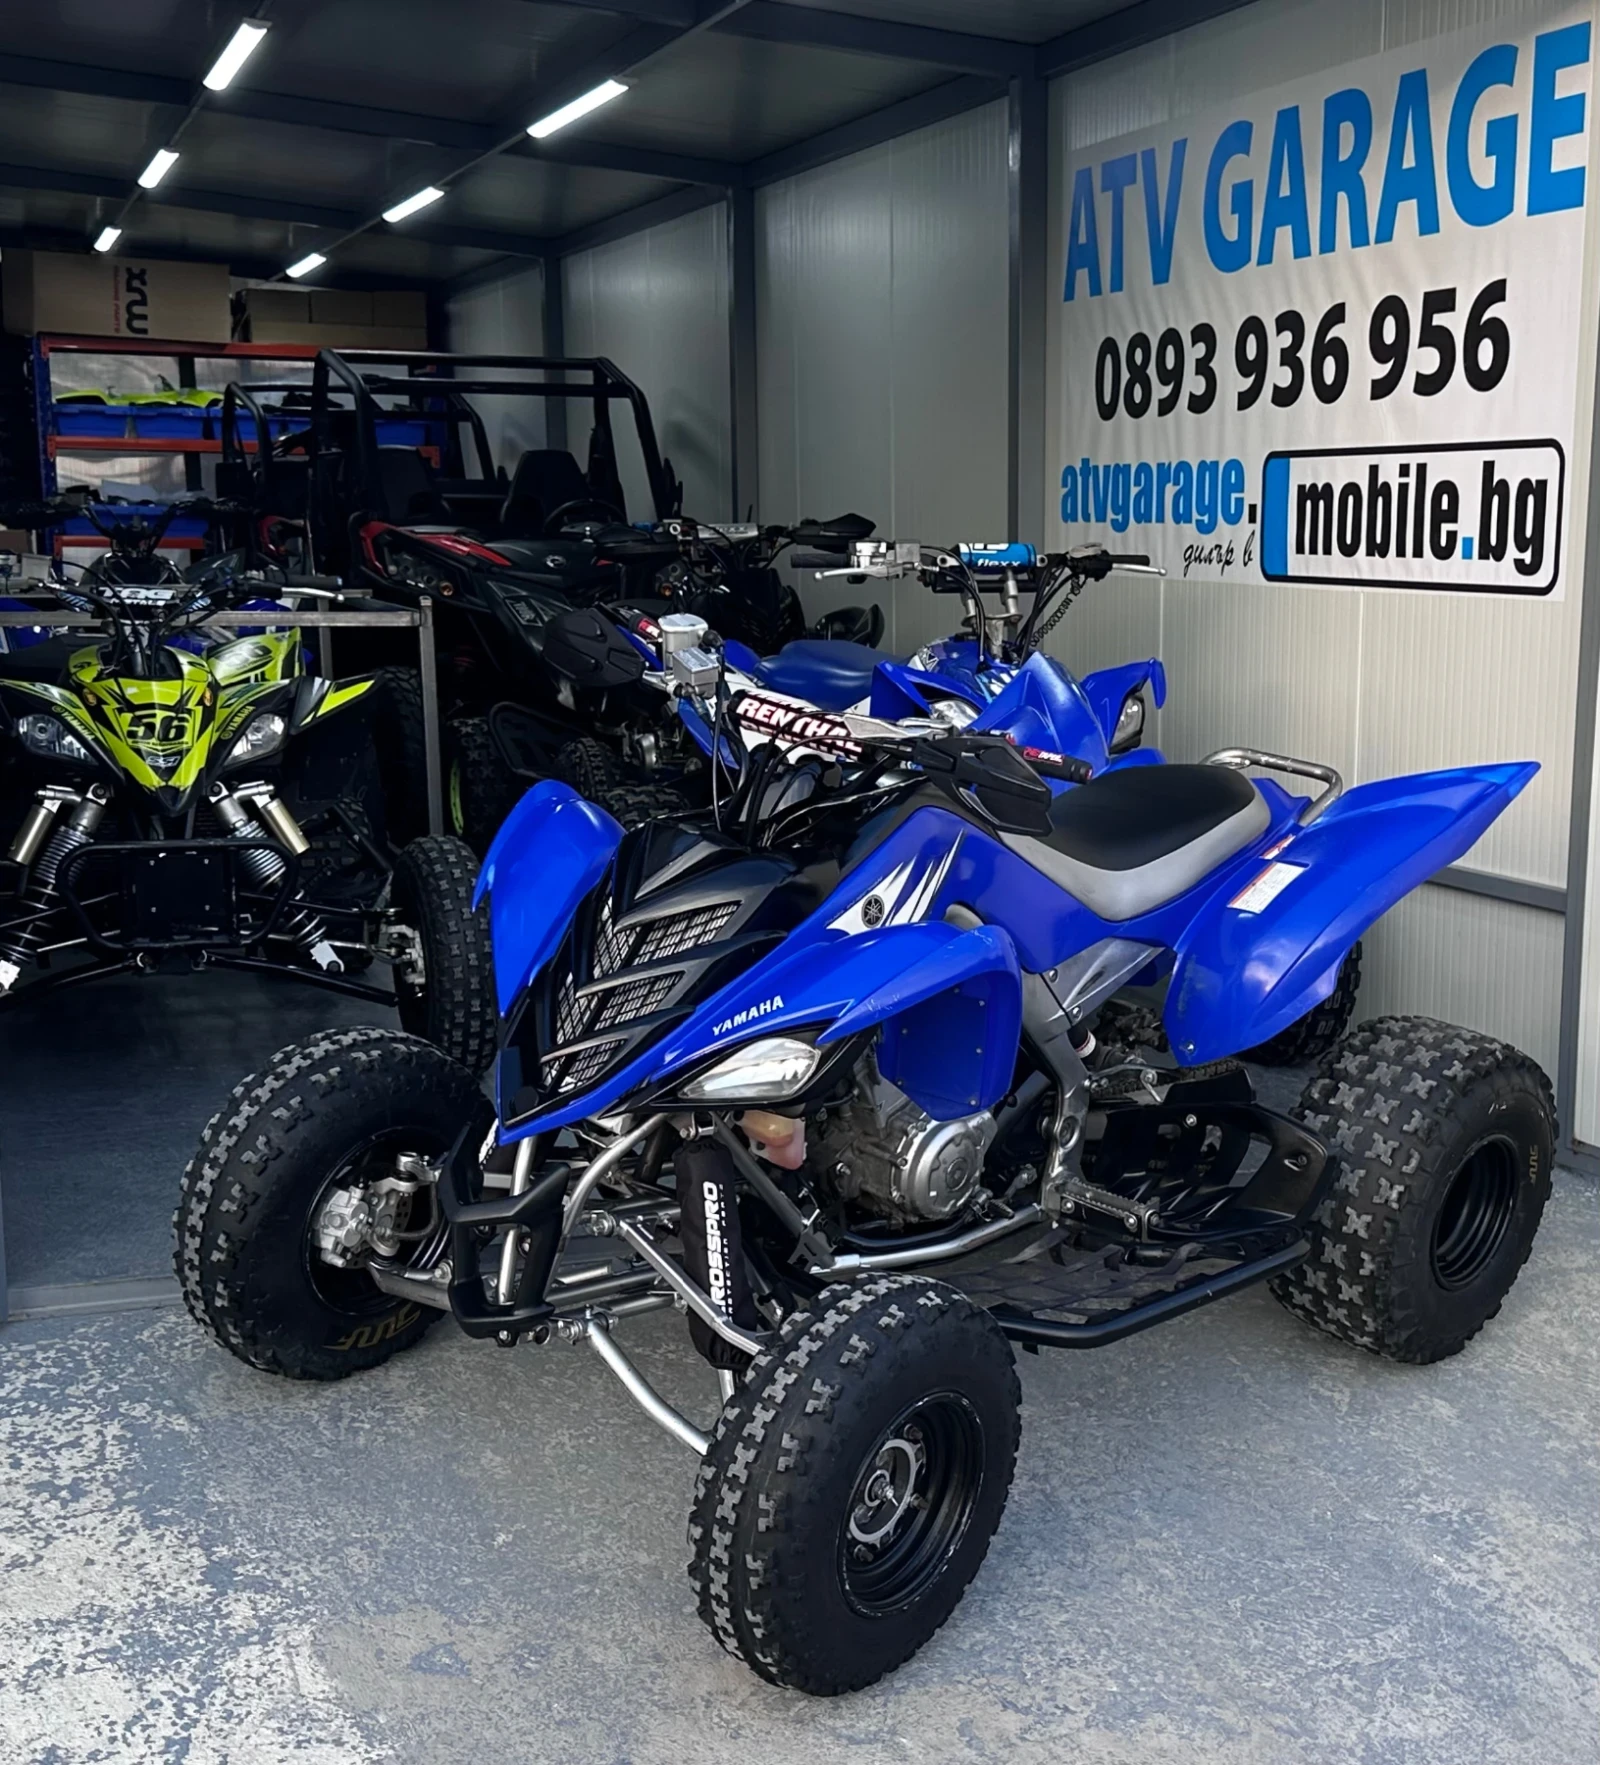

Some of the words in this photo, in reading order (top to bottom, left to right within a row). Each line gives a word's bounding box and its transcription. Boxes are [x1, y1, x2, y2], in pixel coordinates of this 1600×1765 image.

[1063, 138, 1188, 302] ATV
[1203, 20, 1591, 274] GARAGE
[1095, 322, 1217, 421] 0893
[1234, 301, 1350, 412] 936
[1369, 278, 1510, 400] 956
[1295, 460, 1548, 576] mobile.bg
[126, 709, 189, 742] 56
[712, 995, 784, 1036] YAMAHA
[703, 1181, 727, 1314] ROSSPRO
